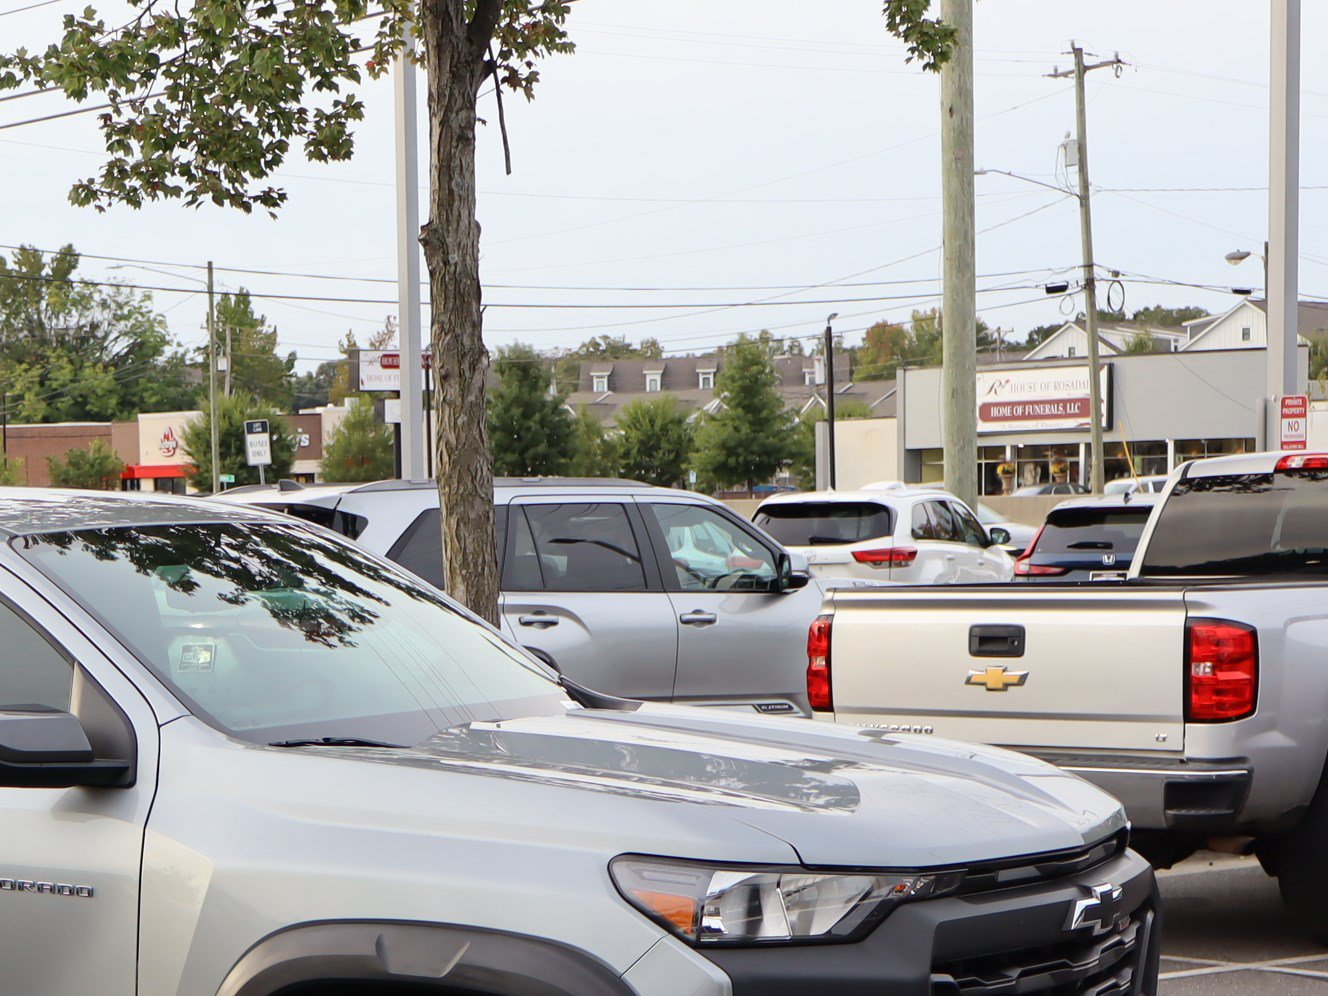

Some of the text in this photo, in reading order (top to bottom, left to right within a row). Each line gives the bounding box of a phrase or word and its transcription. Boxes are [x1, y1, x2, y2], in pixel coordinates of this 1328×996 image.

[1010, 382, 1036, 393] HOUSE
[1039, 381, 1051, 392] OF
[991, 402, 1081, 417] HOME OF FUNERALS, LLC
[1282, 407, 1305, 415] PROPERTY
[1288, 420, 1300, 432] NO
